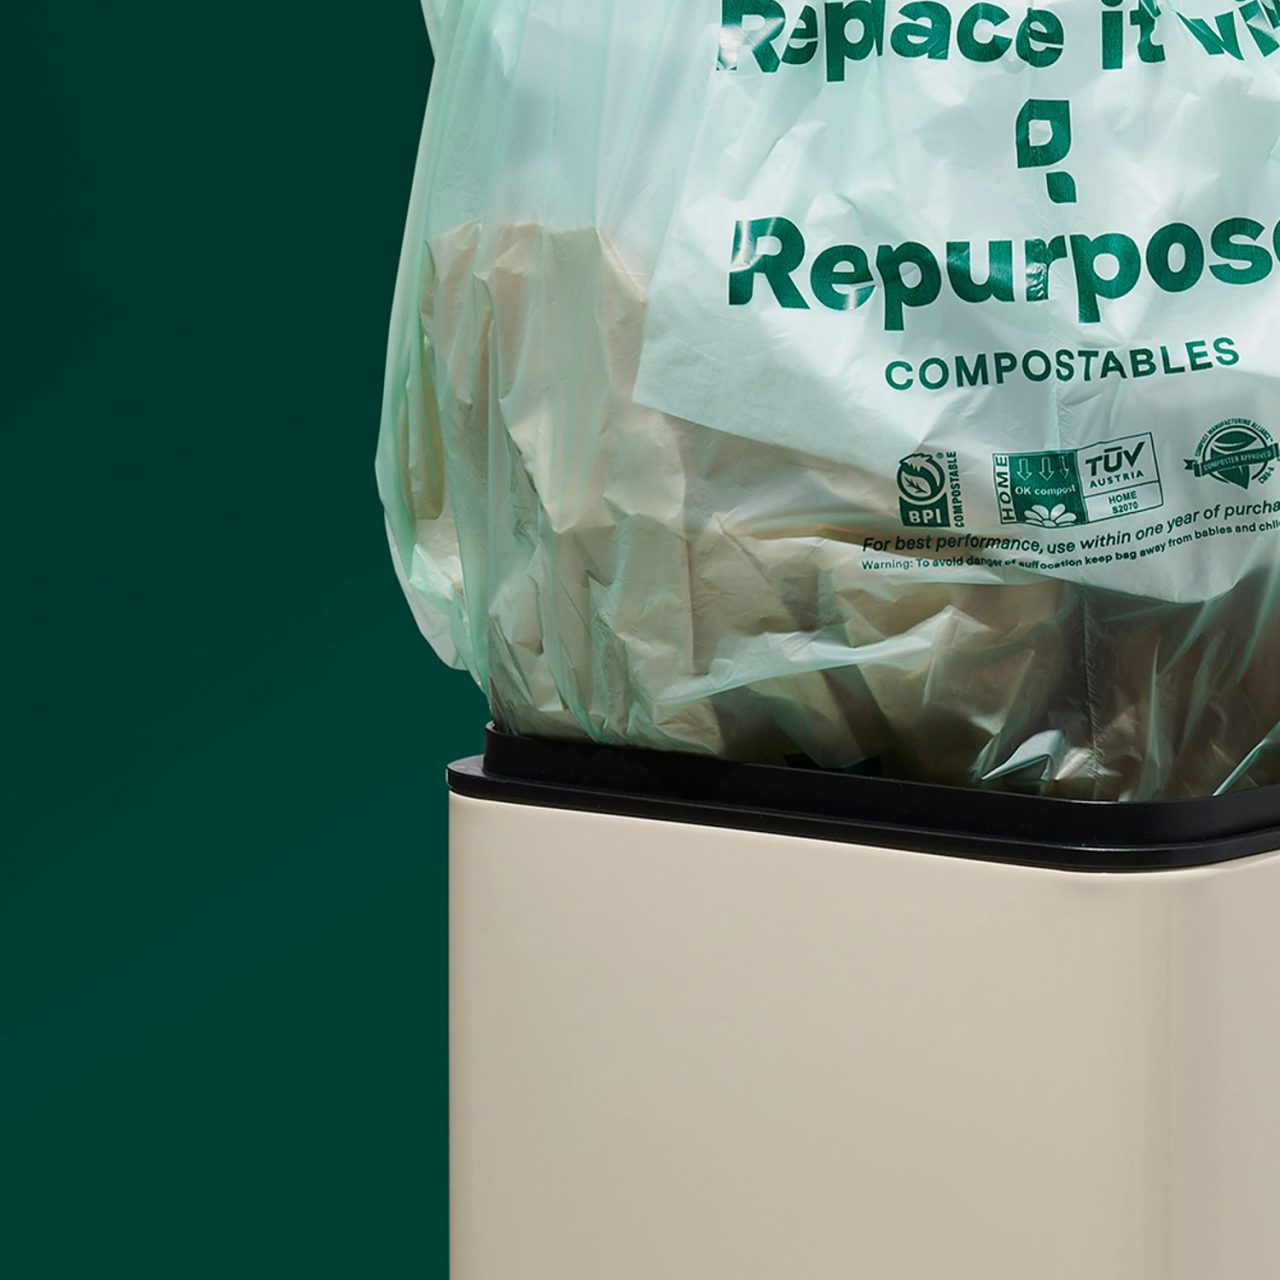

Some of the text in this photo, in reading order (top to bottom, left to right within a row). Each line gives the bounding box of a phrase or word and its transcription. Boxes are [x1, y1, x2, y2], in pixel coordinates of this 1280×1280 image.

[884, 336, 1241, 392] COMPOSTABLES
[945, 451, 966, 528] COMPOSTABLE
[994, 454, 1016, 521] HOME
[1014, 483, 1077, 497] OK compost
[1089, 470, 1145, 489] AUSTRIA
[1107, 490, 1138, 505] HOME
[862, 537, 892, 552] For
[894, 535, 932, 551] best
[935, 533, 1044, 555] performance,
[1046, 540, 1076, 555] use
[1079, 530, 1131, 550] within
[1135, 523, 1164, 541] one
[1167, 510, 1200, 534] year
[1203, 504, 1222, 521] of
[907, 508, 943, 524] BPI
[862, 560, 914, 570] Warning:
[915, 558, 930, 568] To
[932, 555, 964, 567] avoid
[966, 554, 1003, 568] danger
[1084, 554, 1113, 566] keep
[1115, 550, 1138, 561] bag
[1139, 541, 1167, 559] away
[1168, 533, 1193, 548] from
[1194, 525, 1233, 540] babies
[1235, 522, 1257, 534] and
